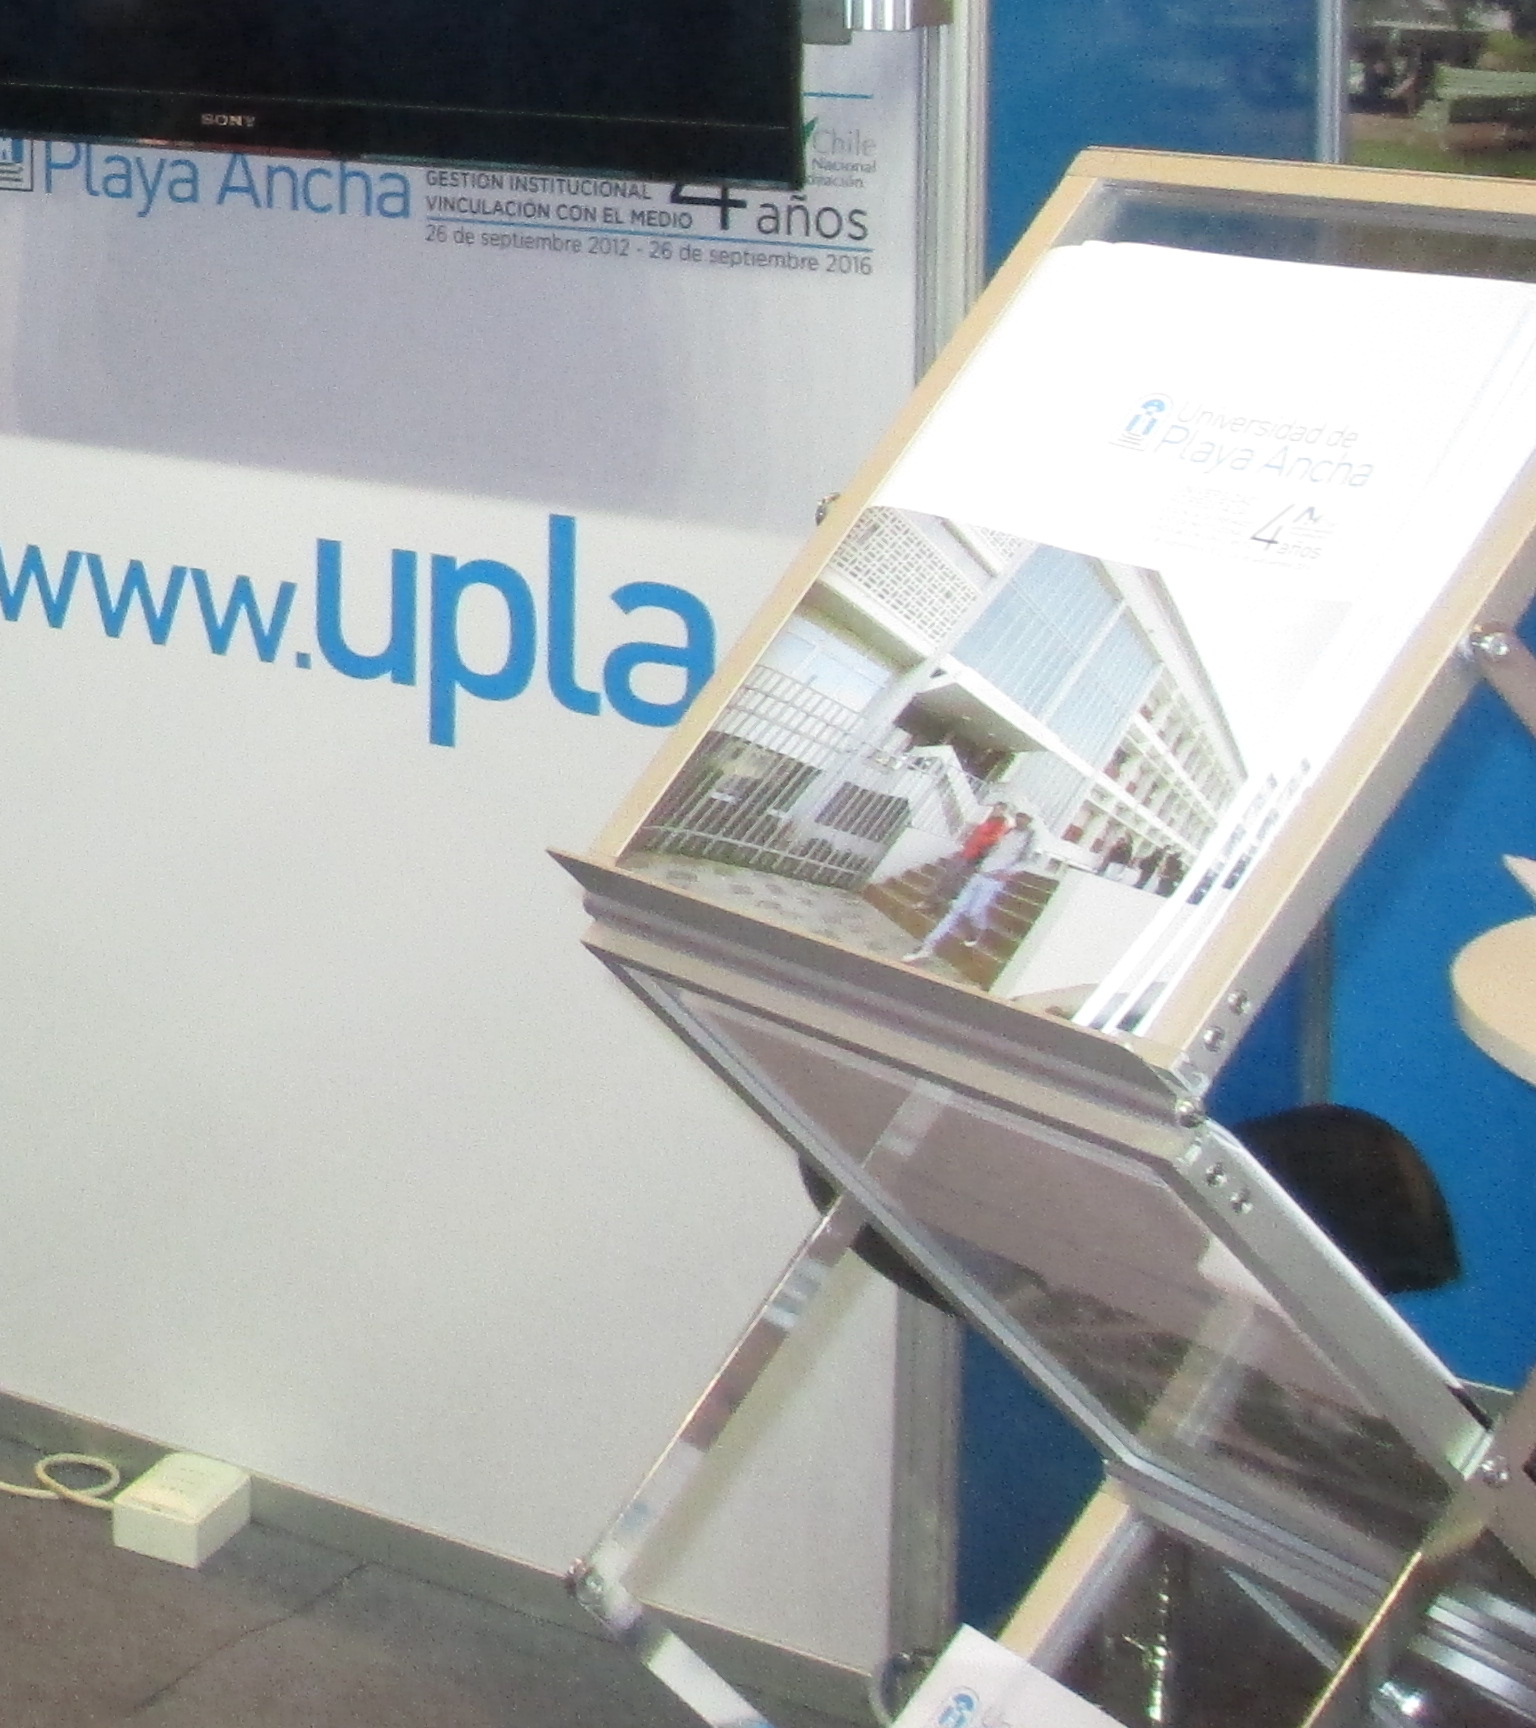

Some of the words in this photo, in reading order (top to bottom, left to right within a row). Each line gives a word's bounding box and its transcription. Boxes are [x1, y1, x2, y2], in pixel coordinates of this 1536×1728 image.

[200, 112, 257, 128] SONY
[811, 129, 878, 157] Chile
[43, 138, 200, 217] Playa
[216, 149, 412, 219] Ancha
[509, 174, 653, 200] INSTITUCIONAL
[556, 207, 598, 224] CON
[602, 209, 626, 225] EL
[631, 211, 693, 230] MEDIO
[757, 194, 869, 241] años
[425, 223, 448, 243] 26
[452, 226, 476, 245] de
[480, 228, 583, 255] septiembre
[588, 237, 630, 257] 2012
[649, 240, 673, 260] 26
[679, 243, 703, 263] de
[709, 246, 820, 275] septiembre
[825, 254, 874, 276] 2016
[1176, 400, 1328, 443] Universidad
[1329, 423, 1359, 449] de
[1154, 424, 1254, 474] Playa
[1263, 445, 1374, 489] Ancha
